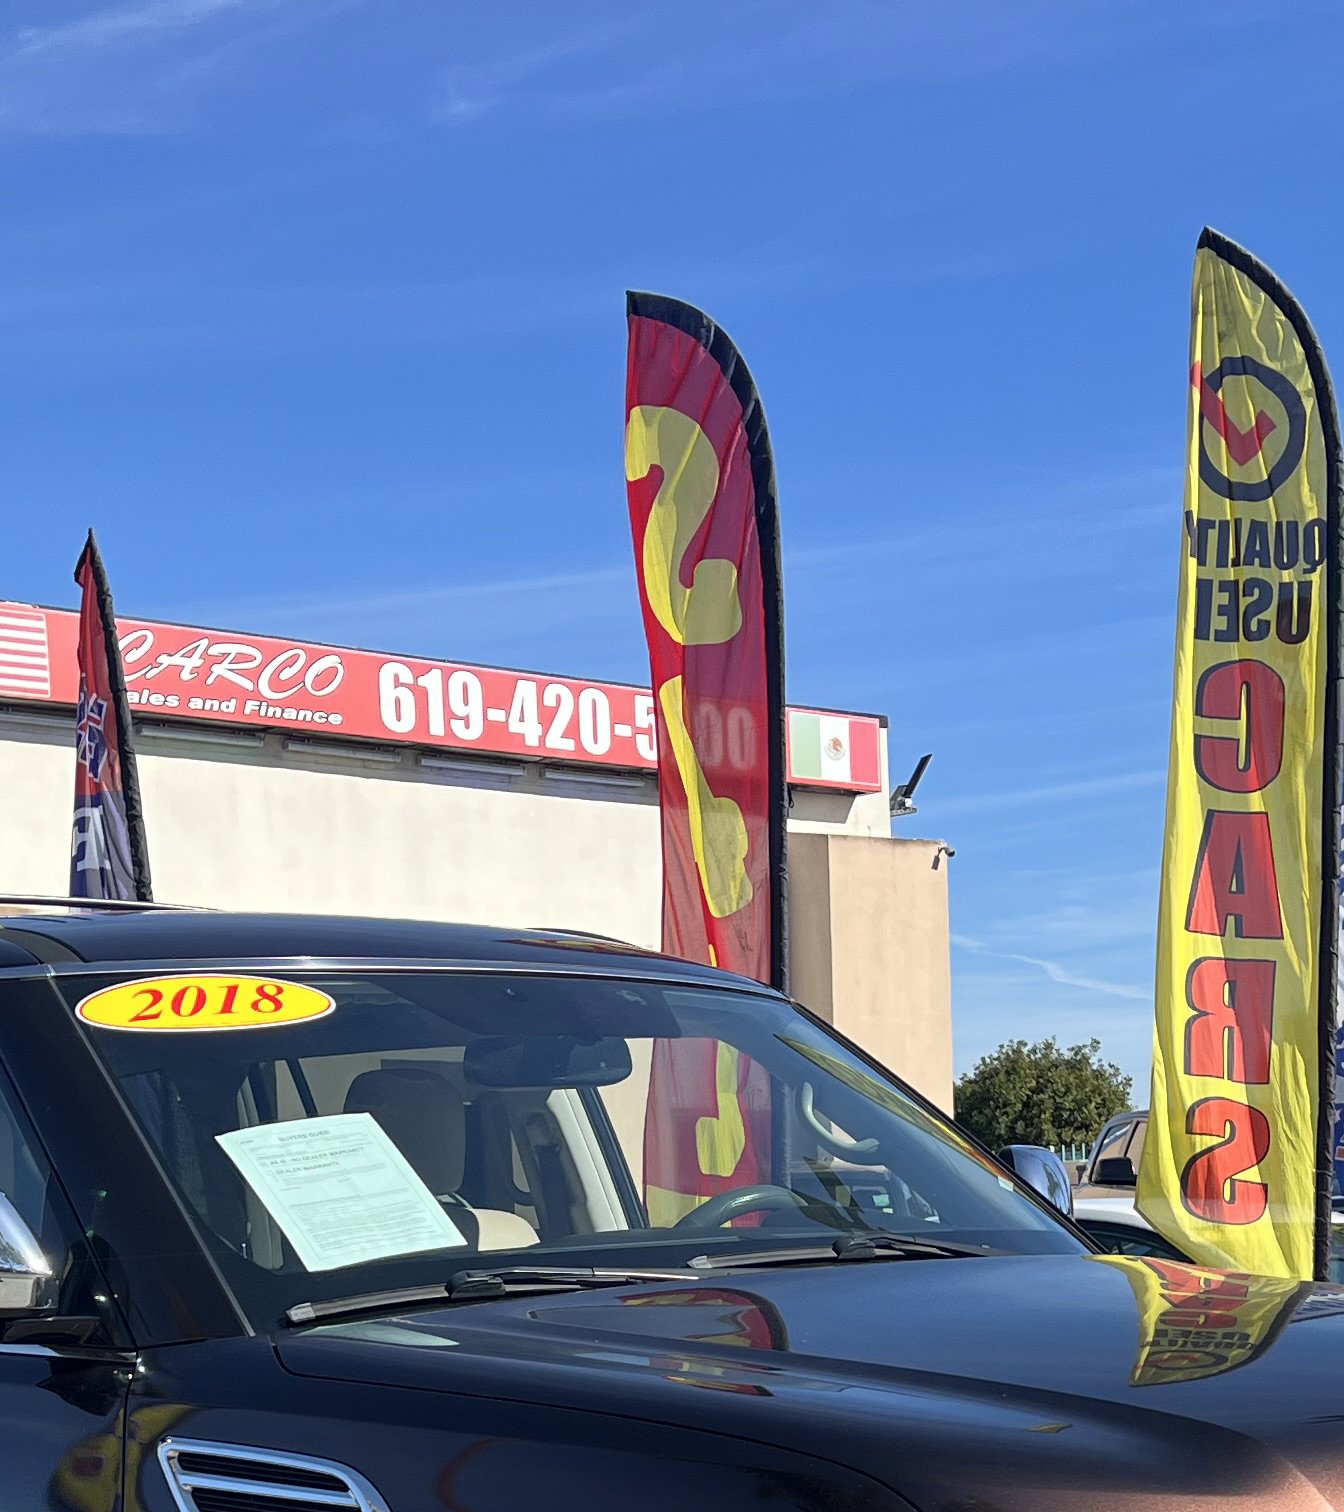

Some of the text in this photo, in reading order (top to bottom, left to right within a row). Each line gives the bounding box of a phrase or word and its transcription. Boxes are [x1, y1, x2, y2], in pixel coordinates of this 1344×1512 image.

[118, 629, 344, 699] CARCO
[127, 690, 344, 725] ales and Finance
[378, 661, 754, 770] 619-420-500
[128, 984, 284, 1022] 2018
